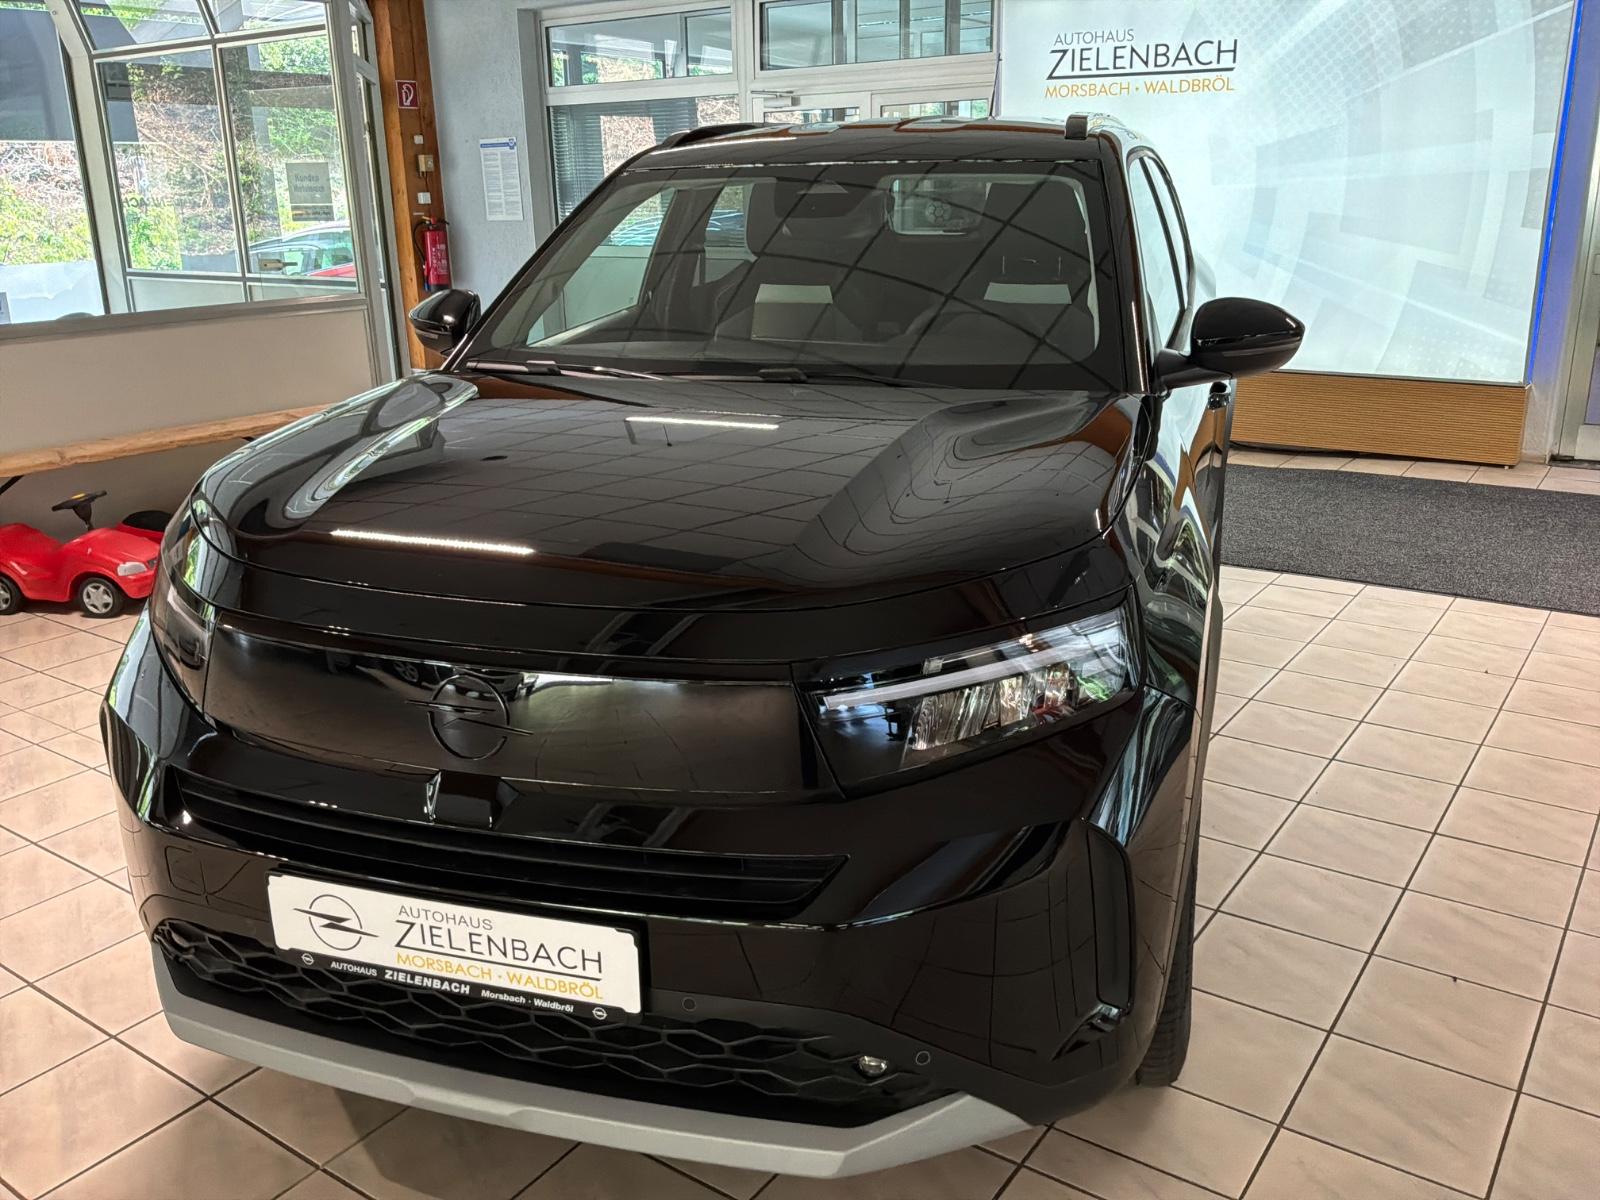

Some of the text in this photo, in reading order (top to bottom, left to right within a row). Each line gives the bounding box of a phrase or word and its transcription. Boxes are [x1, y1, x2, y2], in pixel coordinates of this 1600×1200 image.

[1054, 29, 1135, 46] AUTOHAUS
[1046, 39, 1238, 80] ZIELENBACH
[1045, 75, 1235, 98] MORSBACH WALDBRÖL
[399, 905, 493, 931] AUTOHAUS
[395, 919, 602, 974] ZIELENBACH
[331, 961, 574, 1012] AUTOHAUS ZIELENBACH Morsbach Waldbröl
[397, 952, 603, 1000] MORSBACH WALDBRÖL
